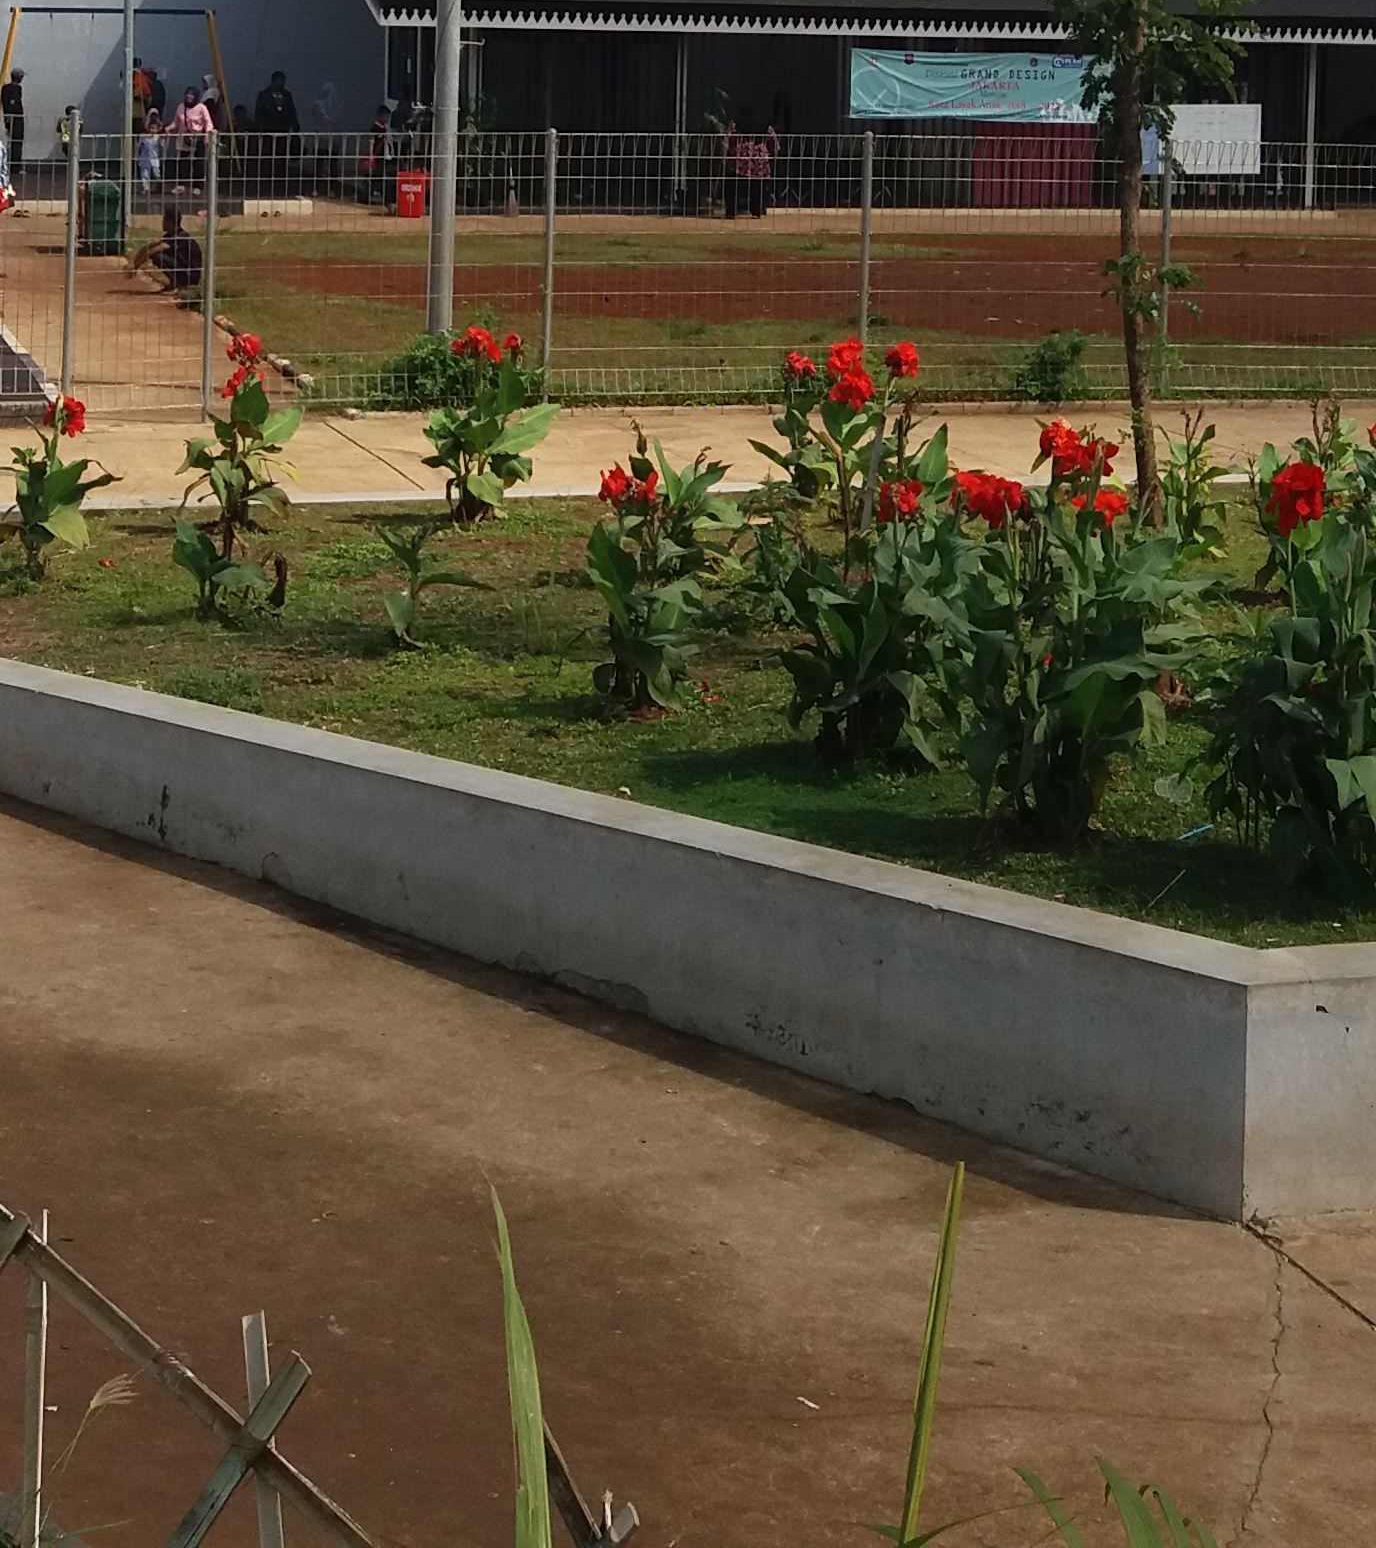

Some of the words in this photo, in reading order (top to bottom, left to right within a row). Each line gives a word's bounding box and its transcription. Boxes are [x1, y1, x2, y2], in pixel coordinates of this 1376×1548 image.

[961, 69, 999, 79] GRAND
[1009, 70, 1055, 80] DESIGN
[970, 81, 1020, 90] JAKARTA
[980, 98, 1001, 109] Anak
